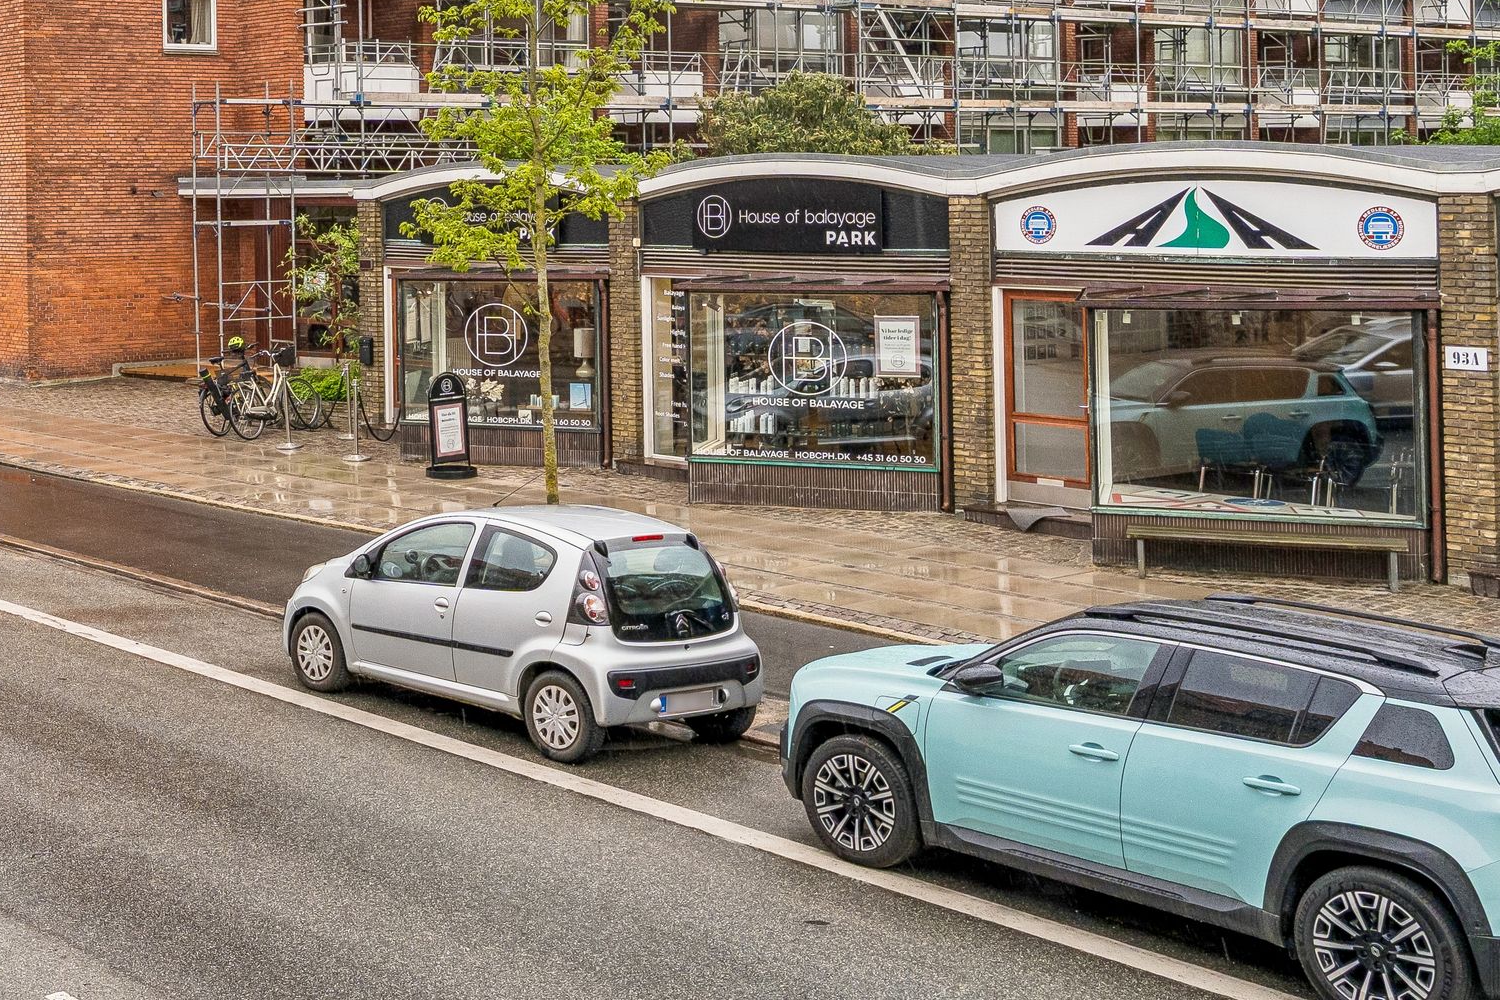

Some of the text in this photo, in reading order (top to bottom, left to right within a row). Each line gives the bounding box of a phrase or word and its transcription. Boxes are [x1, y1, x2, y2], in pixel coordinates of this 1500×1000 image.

[738, 209, 780, 224] House
[785, 209, 800, 224] of
[805, 209, 876, 228] balayage
[825, 230, 877, 247] PARK
[1452, 351, 1479, 366] 93A
[452, 368, 483, 376] HOUSE
[497, 369, 541, 378] BALAYAGE
[752, 397, 865, 410] HOUSE OF BALAYAGE
[486, 416, 533, 425] HOBCPH.DK
[581, 419, 591, 427] 30
[696, 448, 728, 456] HOUSE
[743, 449, 789, 458] BALAYAGE
[794, 451, 851, 461] HOBCPH.DK
[856, 454, 873, 462] +45
[886, 455, 898, 463] 60
[899, 455, 912, 463] 50
[913, 455, 926, 464] 30
